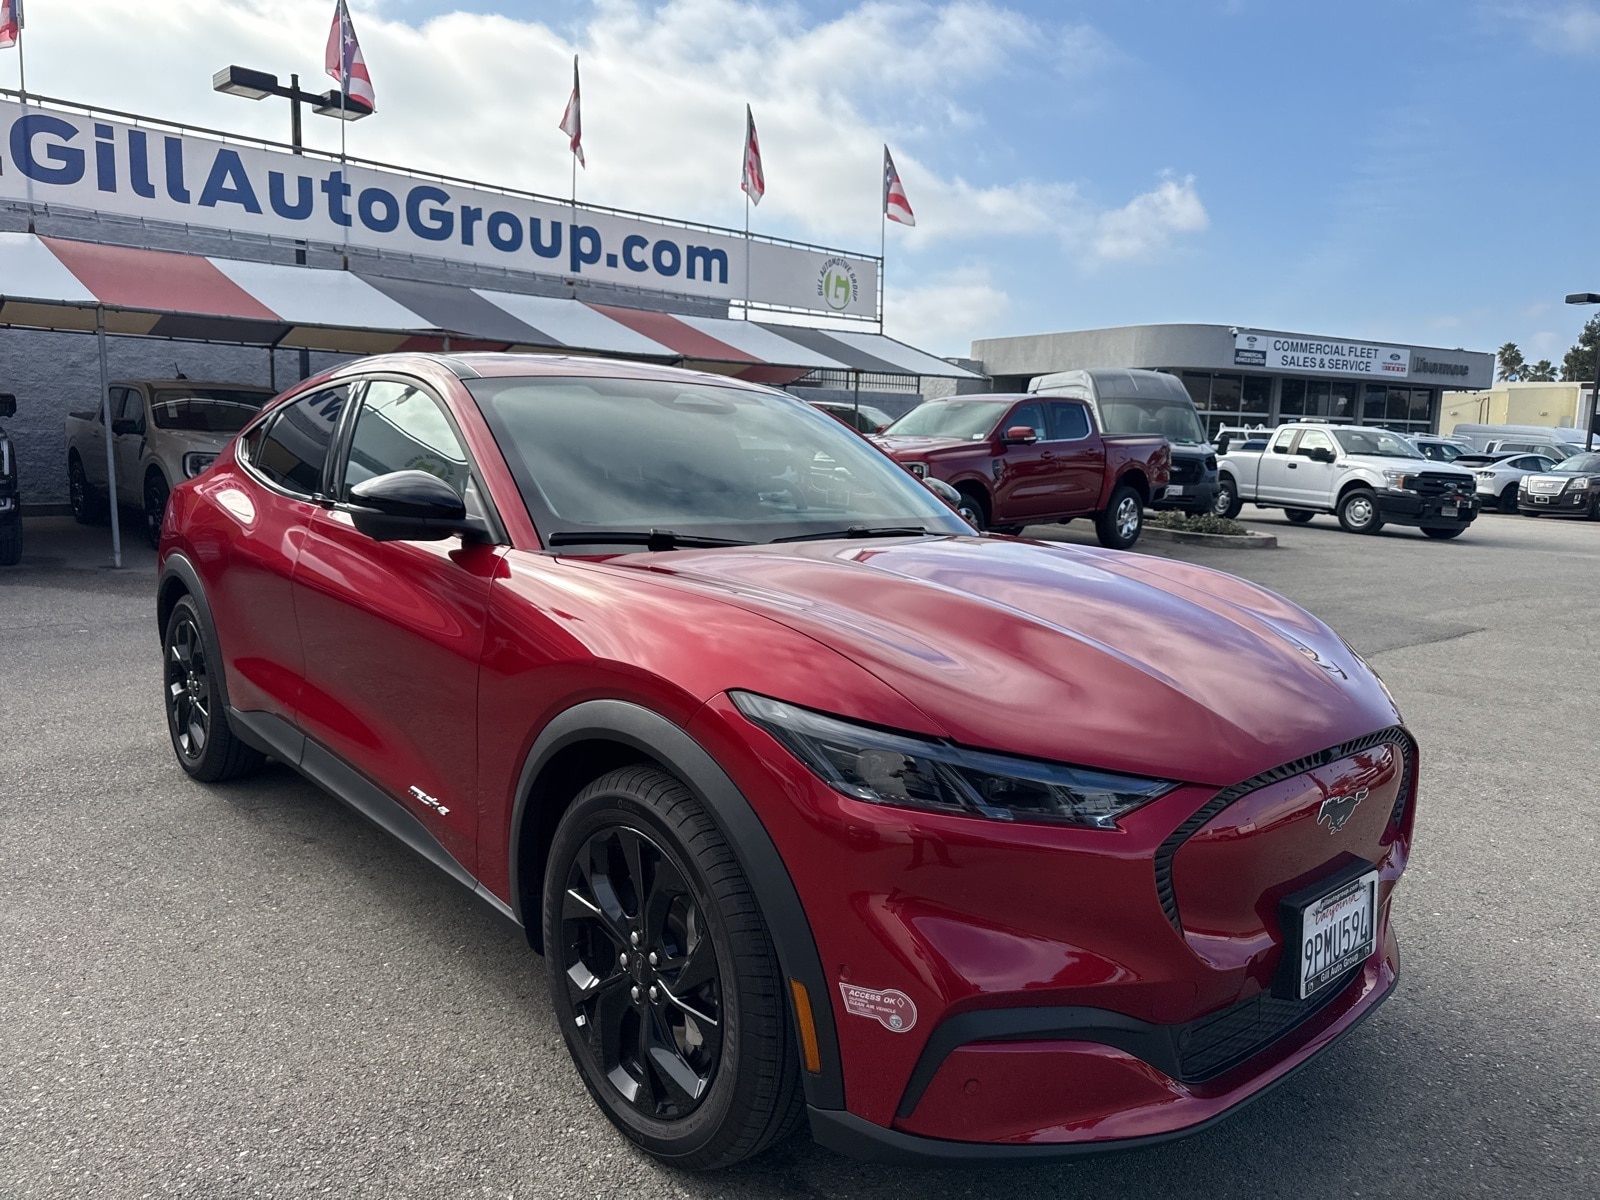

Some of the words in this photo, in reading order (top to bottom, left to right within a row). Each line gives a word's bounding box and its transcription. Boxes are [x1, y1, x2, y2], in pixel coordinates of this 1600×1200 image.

[0, 114, 728, 284] GillAutoGroup.com
[820, 258, 853, 278] AUTOMOTIVE
[850, 273, 858, 302] GROUP
[1273, 339, 1346, 357] COMMERCIAL
[1348, 346, 1379, 359] FLEET
[1281, 355, 1317, 368] SALES
[1318, 358, 1326, 368] &
[1328, 359, 1371, 372] SERVICE
[1304, 905, 1368, 981] 9PMU594
[1320, 970, 1330, 982] Gill
[1330, 963, 1342, 976] Auto
[1343, 954, 1358, 967] Group
[849, 990, 881, 1001] ACCESS
